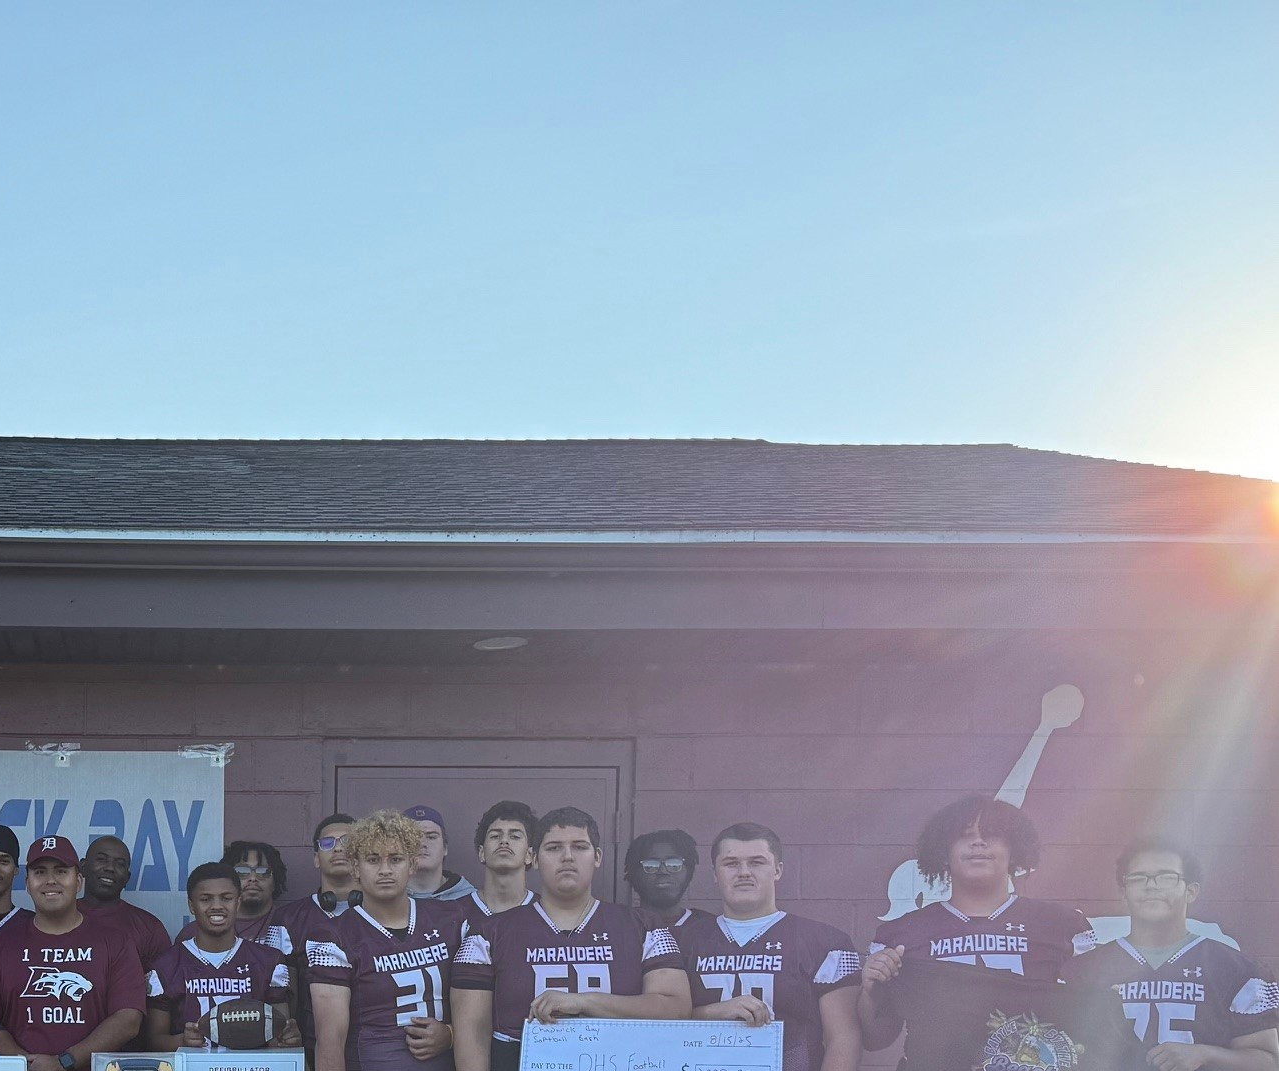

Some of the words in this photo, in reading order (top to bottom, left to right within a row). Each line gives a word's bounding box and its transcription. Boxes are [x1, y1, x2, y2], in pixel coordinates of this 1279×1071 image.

[526, 945, 614, 962] MARAUDERS
[929, 934, 1028, 956] MARAUDERS
[22, 949, 30, 962] 1
[41, 947, 92, 963] TEAM
[373, 942, 449, 973] MARAUDERS
[696, 954, 782, 972] MARAUDERS
[390, 966, 443, 1027] 31
[1118, 980, 1205, 1002] ARAUDERS
[26, 1007, 34, 1023] 1
[42, 1007, 85, 1024] GOAL
[709, 1033, 752, 1046] 8/15/25
[531, 1062, 544, 1070] PAY
[545, 1062, 555, 1070] TO
[557, 1062, 573, 1070] THE
[627, 1053, 665, 1071] Football
